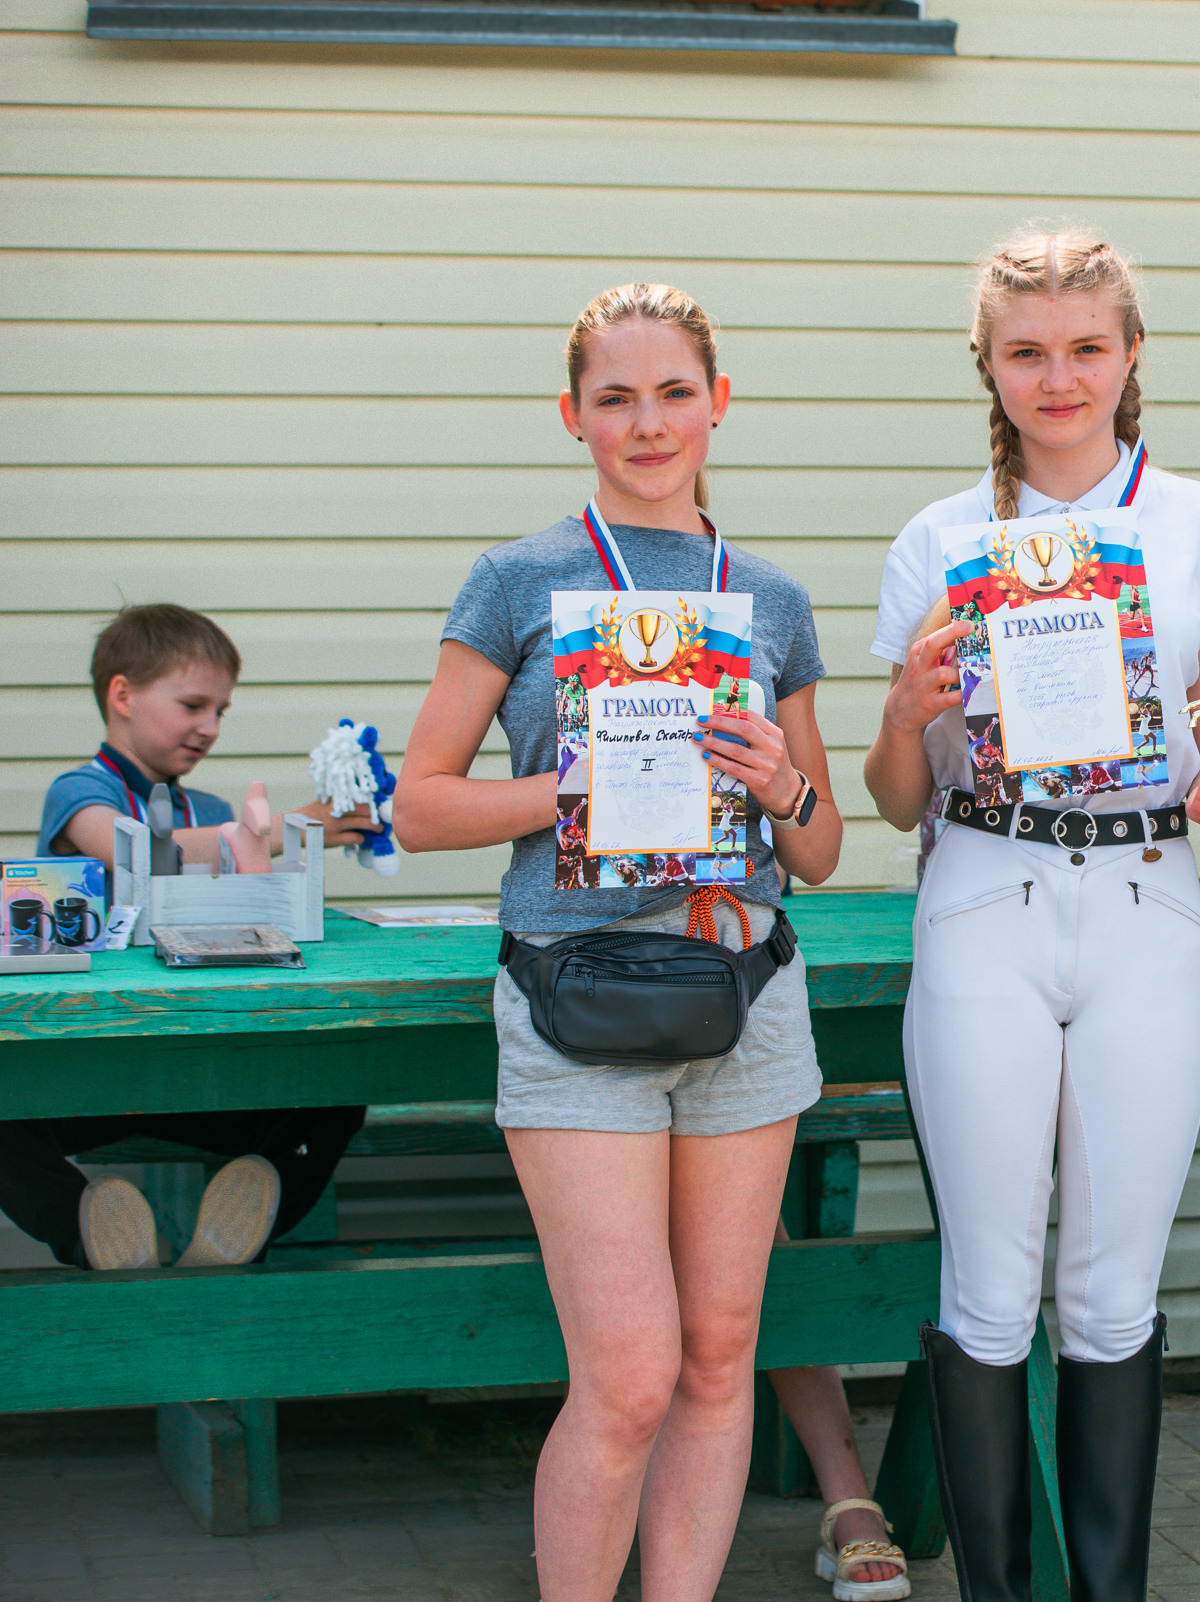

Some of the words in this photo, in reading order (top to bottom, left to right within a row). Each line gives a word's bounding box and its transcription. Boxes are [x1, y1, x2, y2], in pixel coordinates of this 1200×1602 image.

[1002, 611, 1105, 638] ГРАМОТА
[602, 697, 697, 717] ГРАМОТА
[656, 728, 711, 743] Екатера
[640, 758, 657, 771] II
